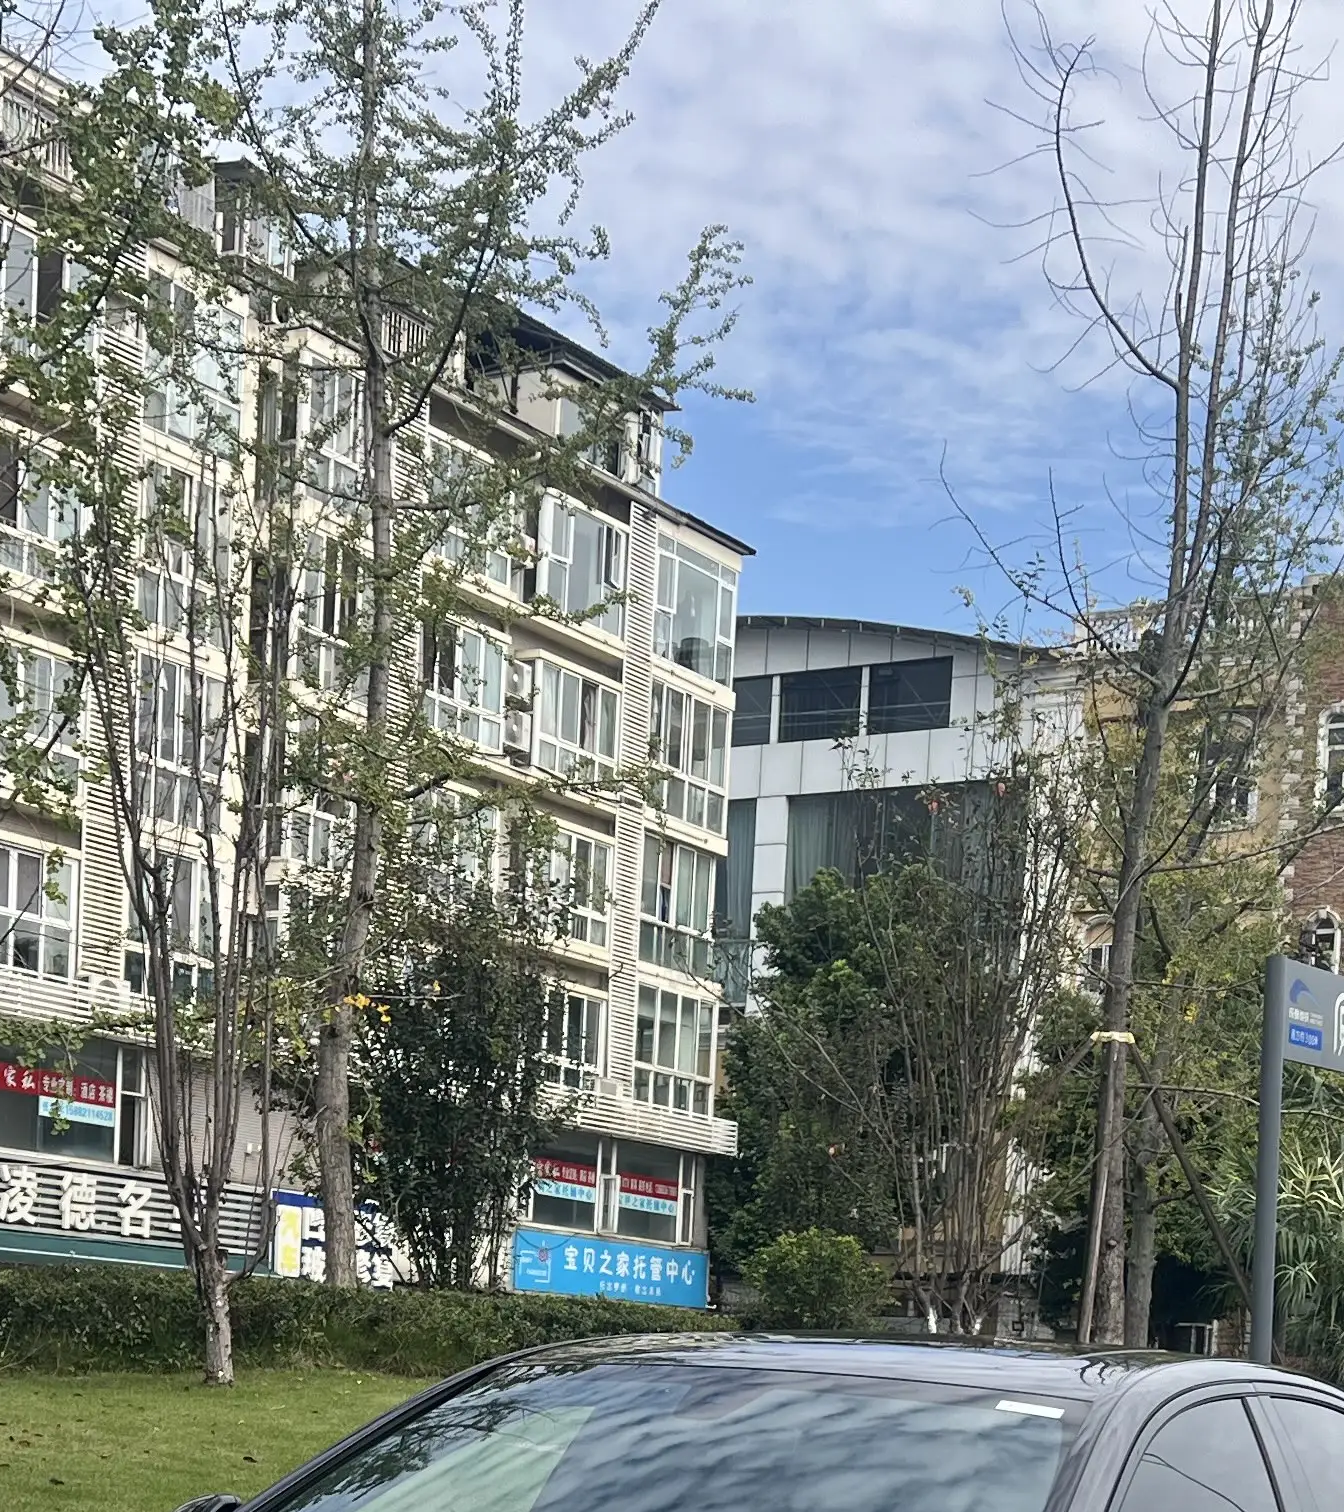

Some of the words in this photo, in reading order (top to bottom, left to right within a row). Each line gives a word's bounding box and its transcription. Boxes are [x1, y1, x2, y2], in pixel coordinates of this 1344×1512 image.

[563, 1245, 696, 1286] 宝贝之家托管中心
